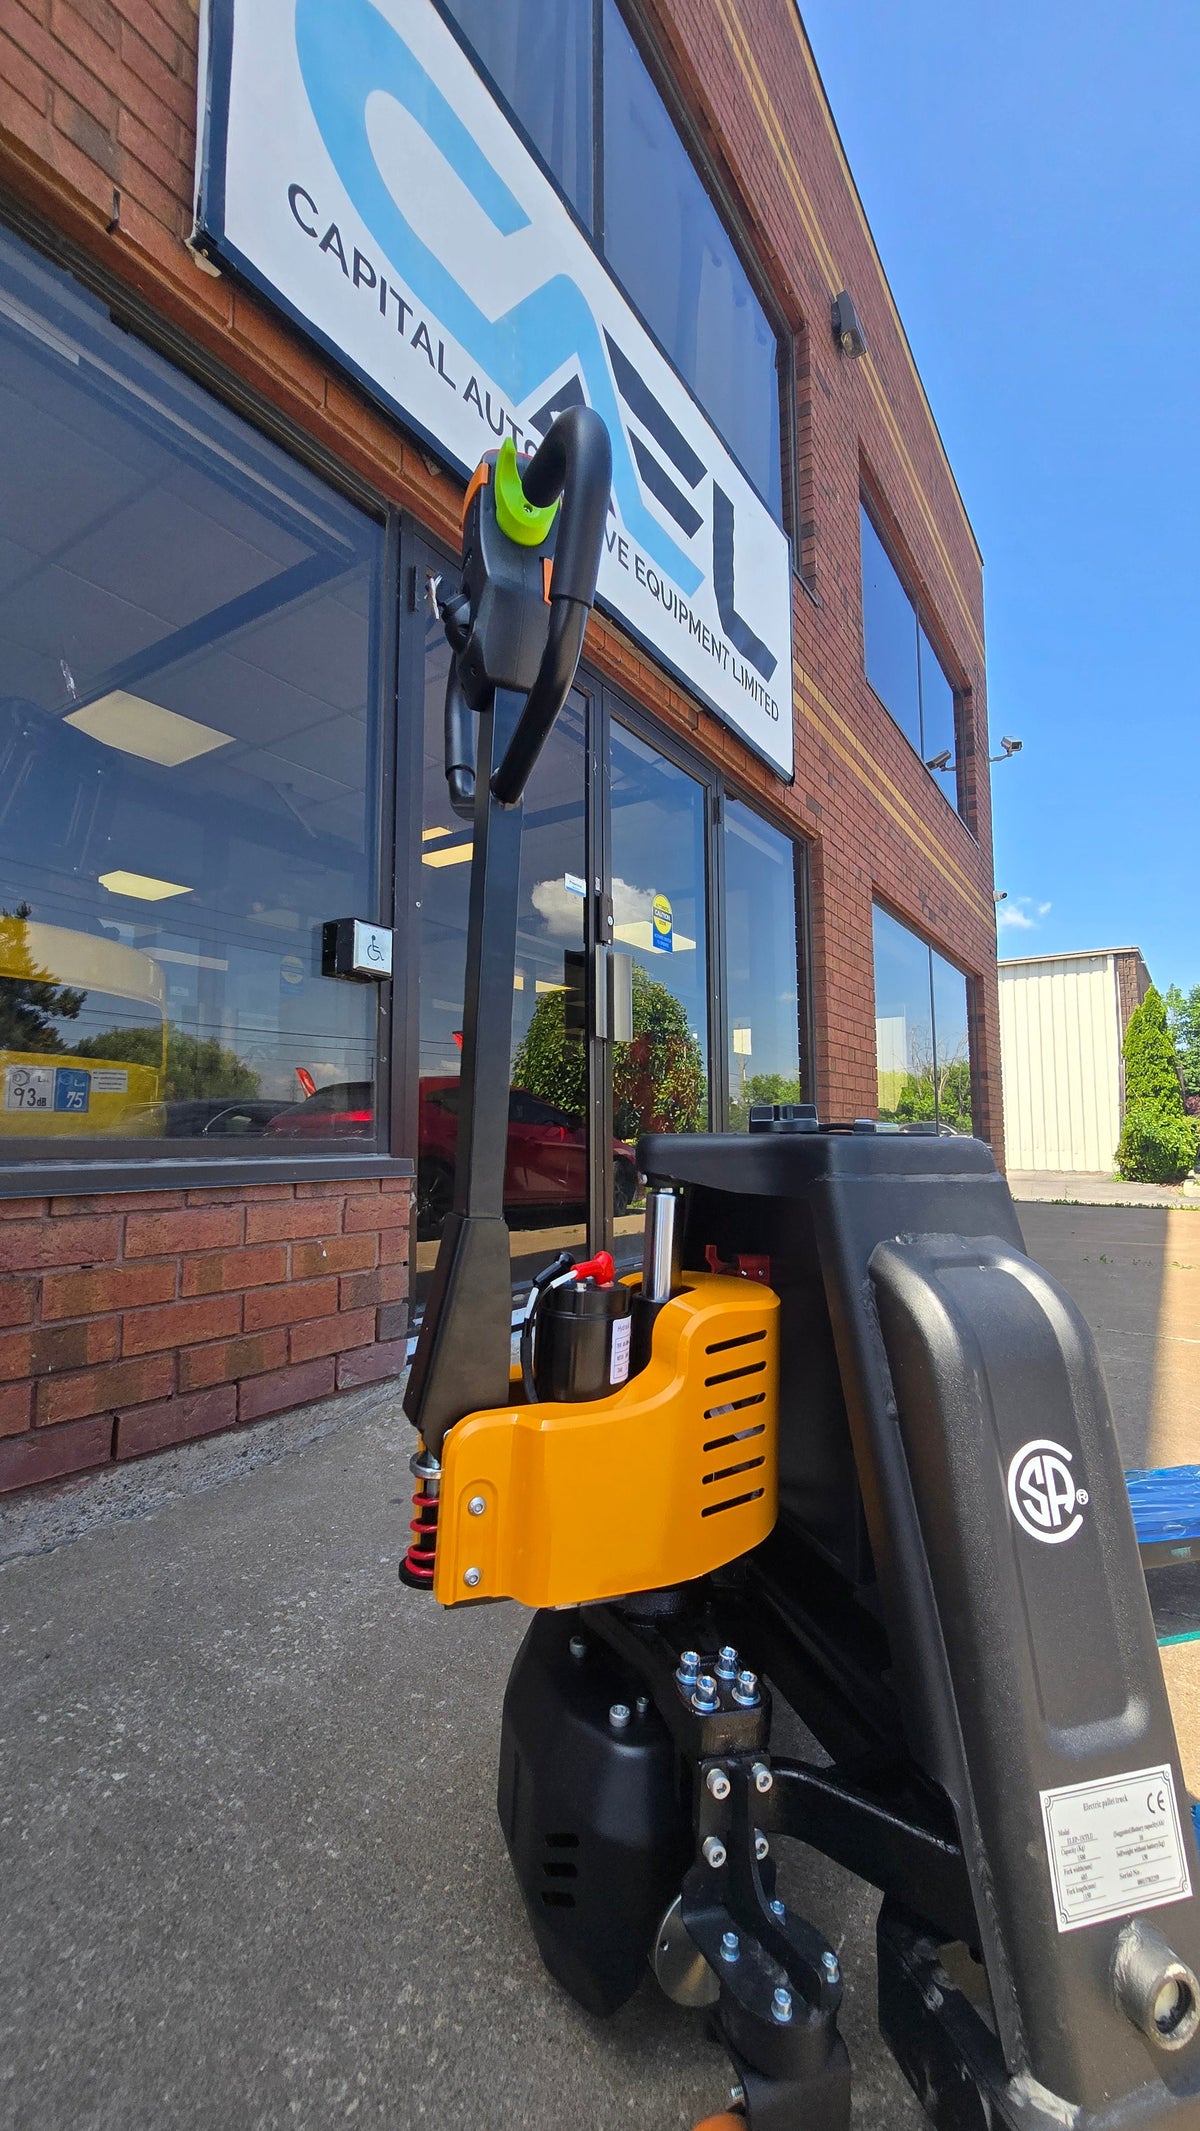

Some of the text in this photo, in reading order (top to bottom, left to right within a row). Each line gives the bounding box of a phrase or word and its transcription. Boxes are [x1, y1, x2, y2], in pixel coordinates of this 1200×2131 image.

[287, 182, 457, 391] CAPITAL
[634, 553, 730, 672] EQUIPMENT
[732, 656, 780, 722] LIMITED
[66, 1091, 85, 1108] 75
[1146, 1790, 1166, 1814] CE
